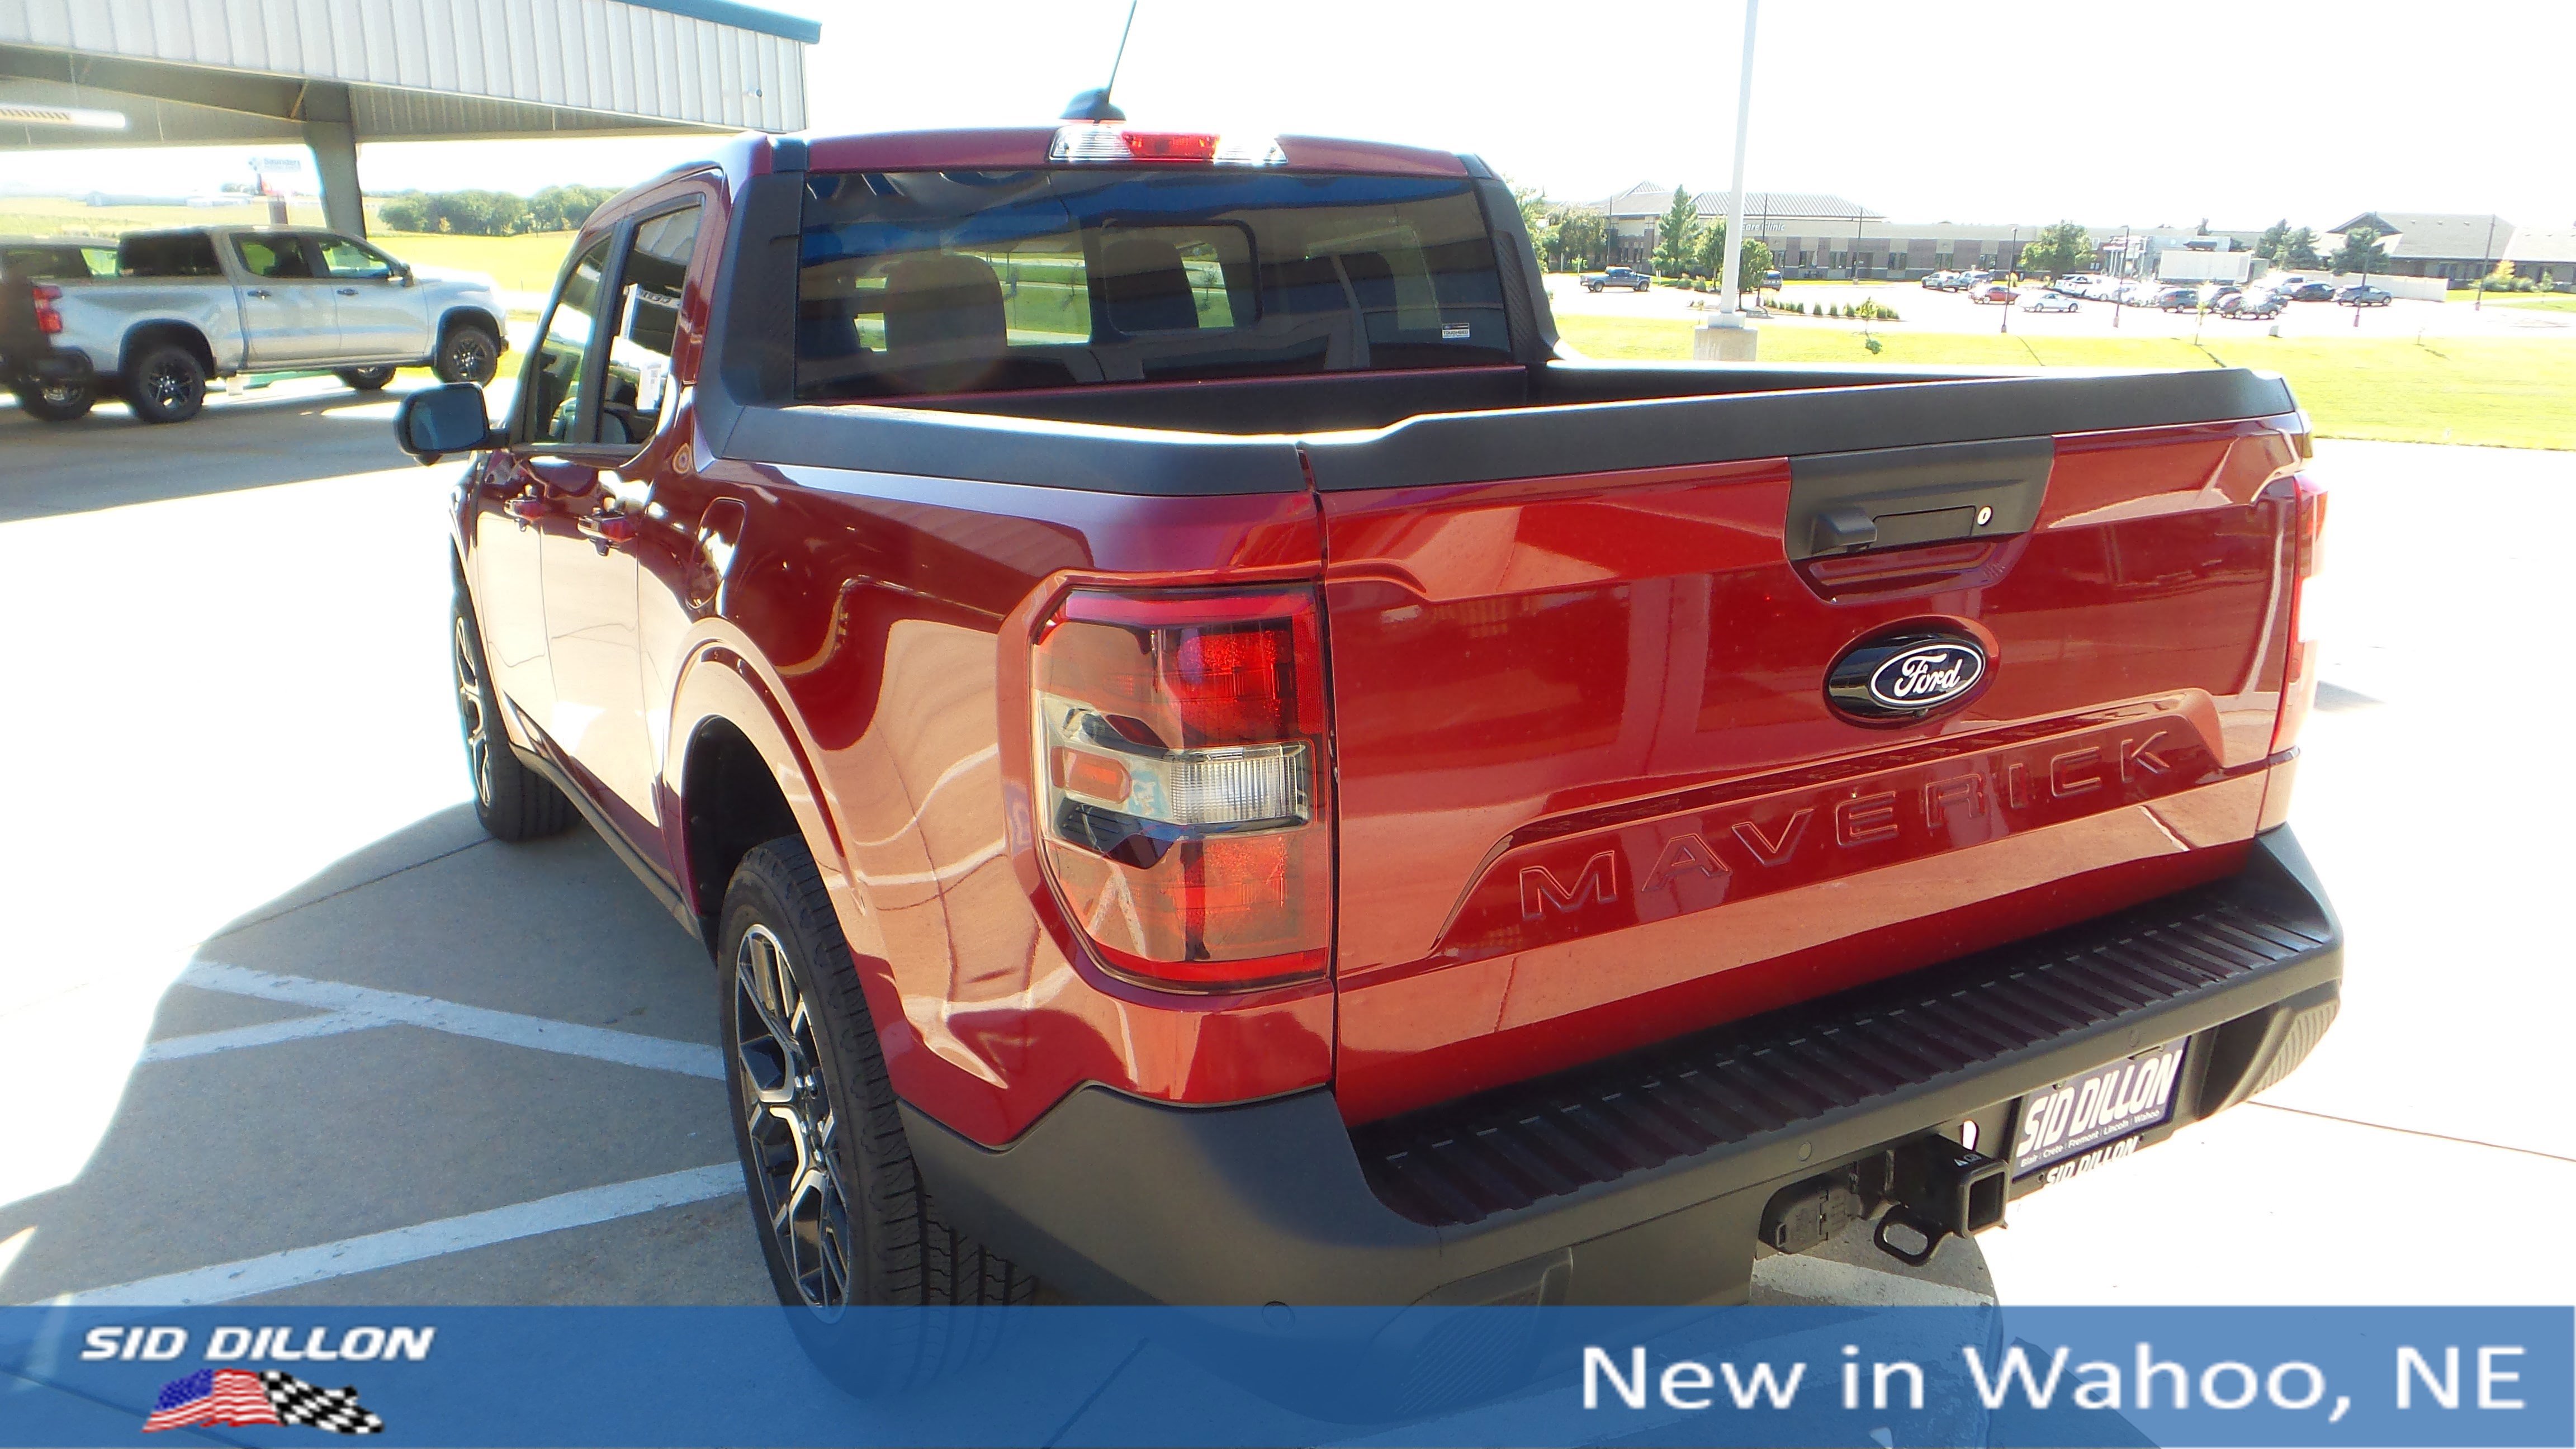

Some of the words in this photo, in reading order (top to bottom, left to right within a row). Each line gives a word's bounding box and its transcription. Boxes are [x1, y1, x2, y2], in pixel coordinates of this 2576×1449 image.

[1761, 221, 1786, 231] Clinic
[1894, 653, 1963, 697] Ford
[1518, 731, 2172, 921] MAVERICK
[2016, 1087, 2075, 1158] SID
[2068, 1049, 2183, 1137] DILLON
